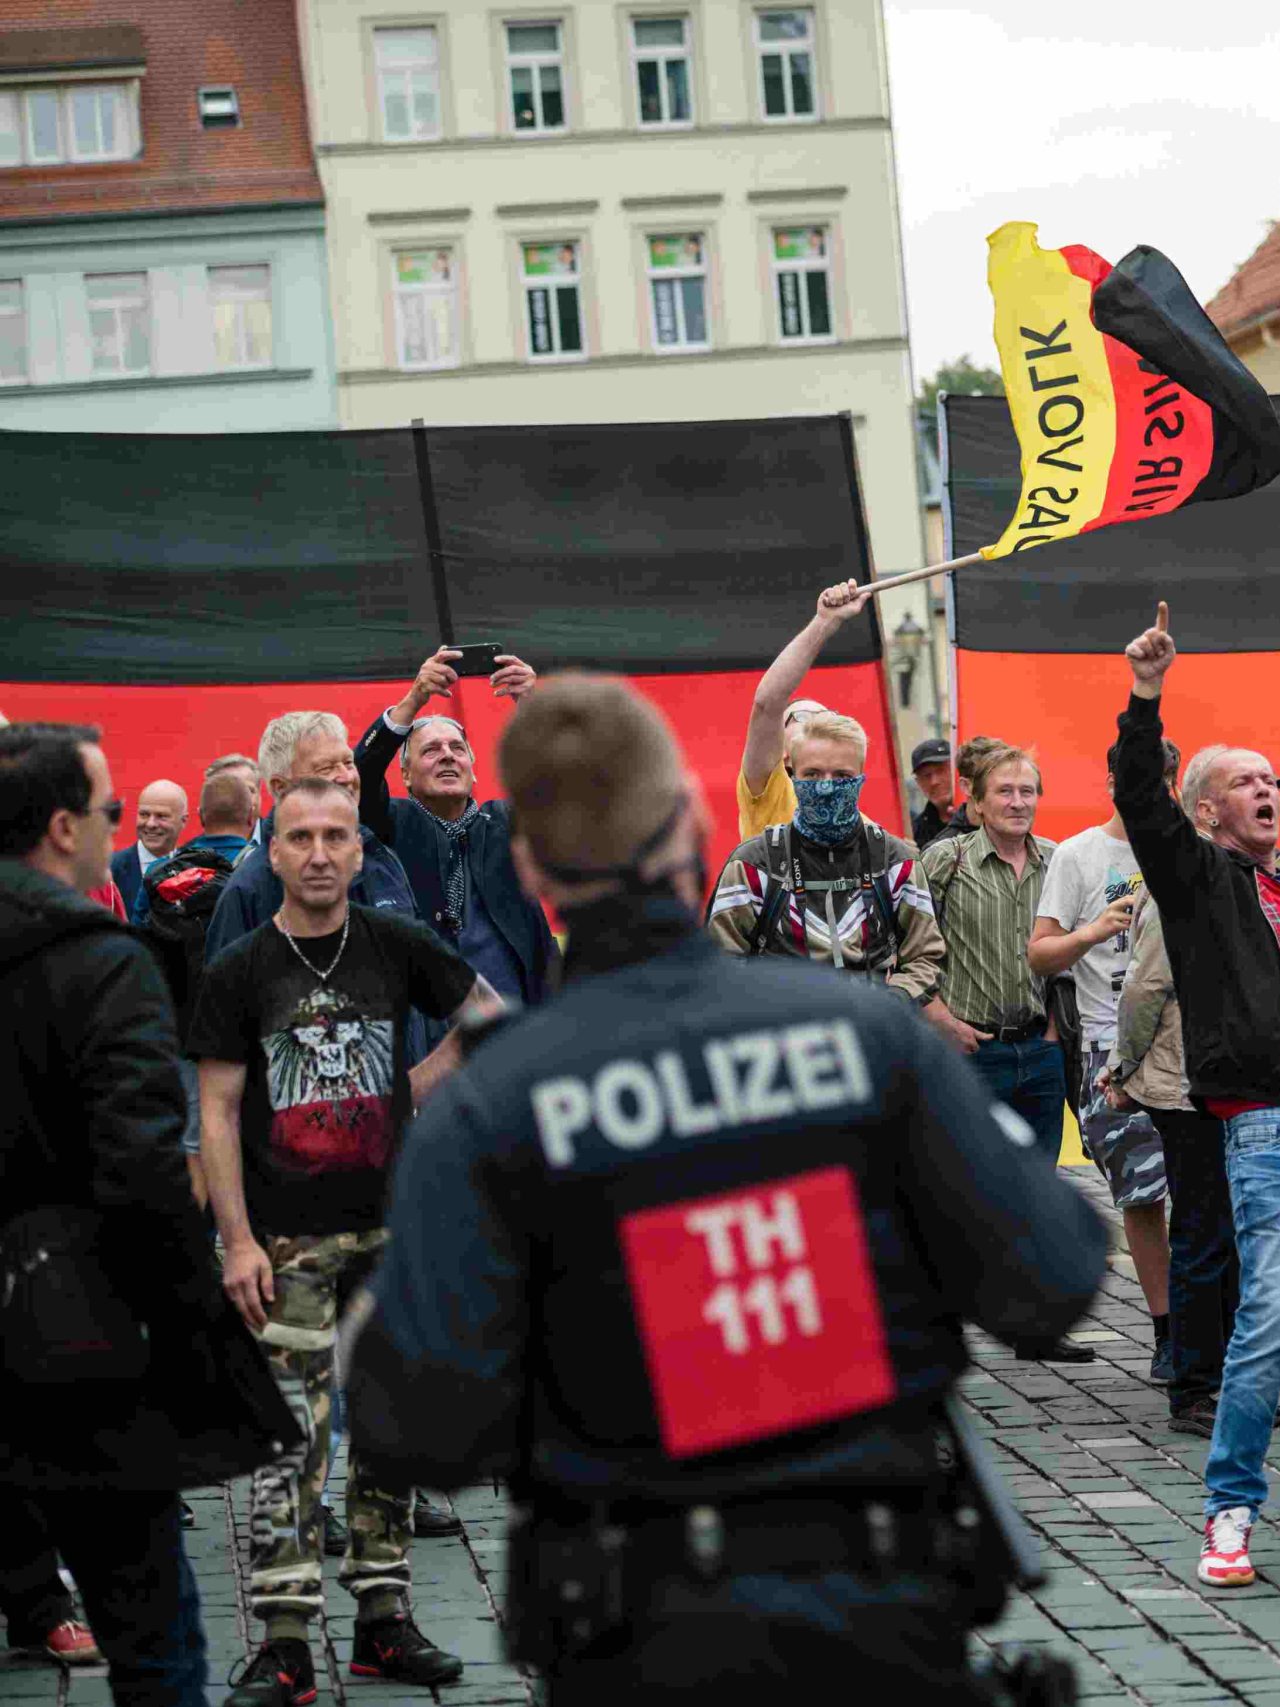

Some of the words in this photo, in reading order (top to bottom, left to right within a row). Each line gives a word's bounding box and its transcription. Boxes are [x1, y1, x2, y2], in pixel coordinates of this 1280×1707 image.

[531, 1017, 872, 1167] POLIZEI
[684, 1189, 806, 1278] TH
[702, 1265, 823, 1355] 111
